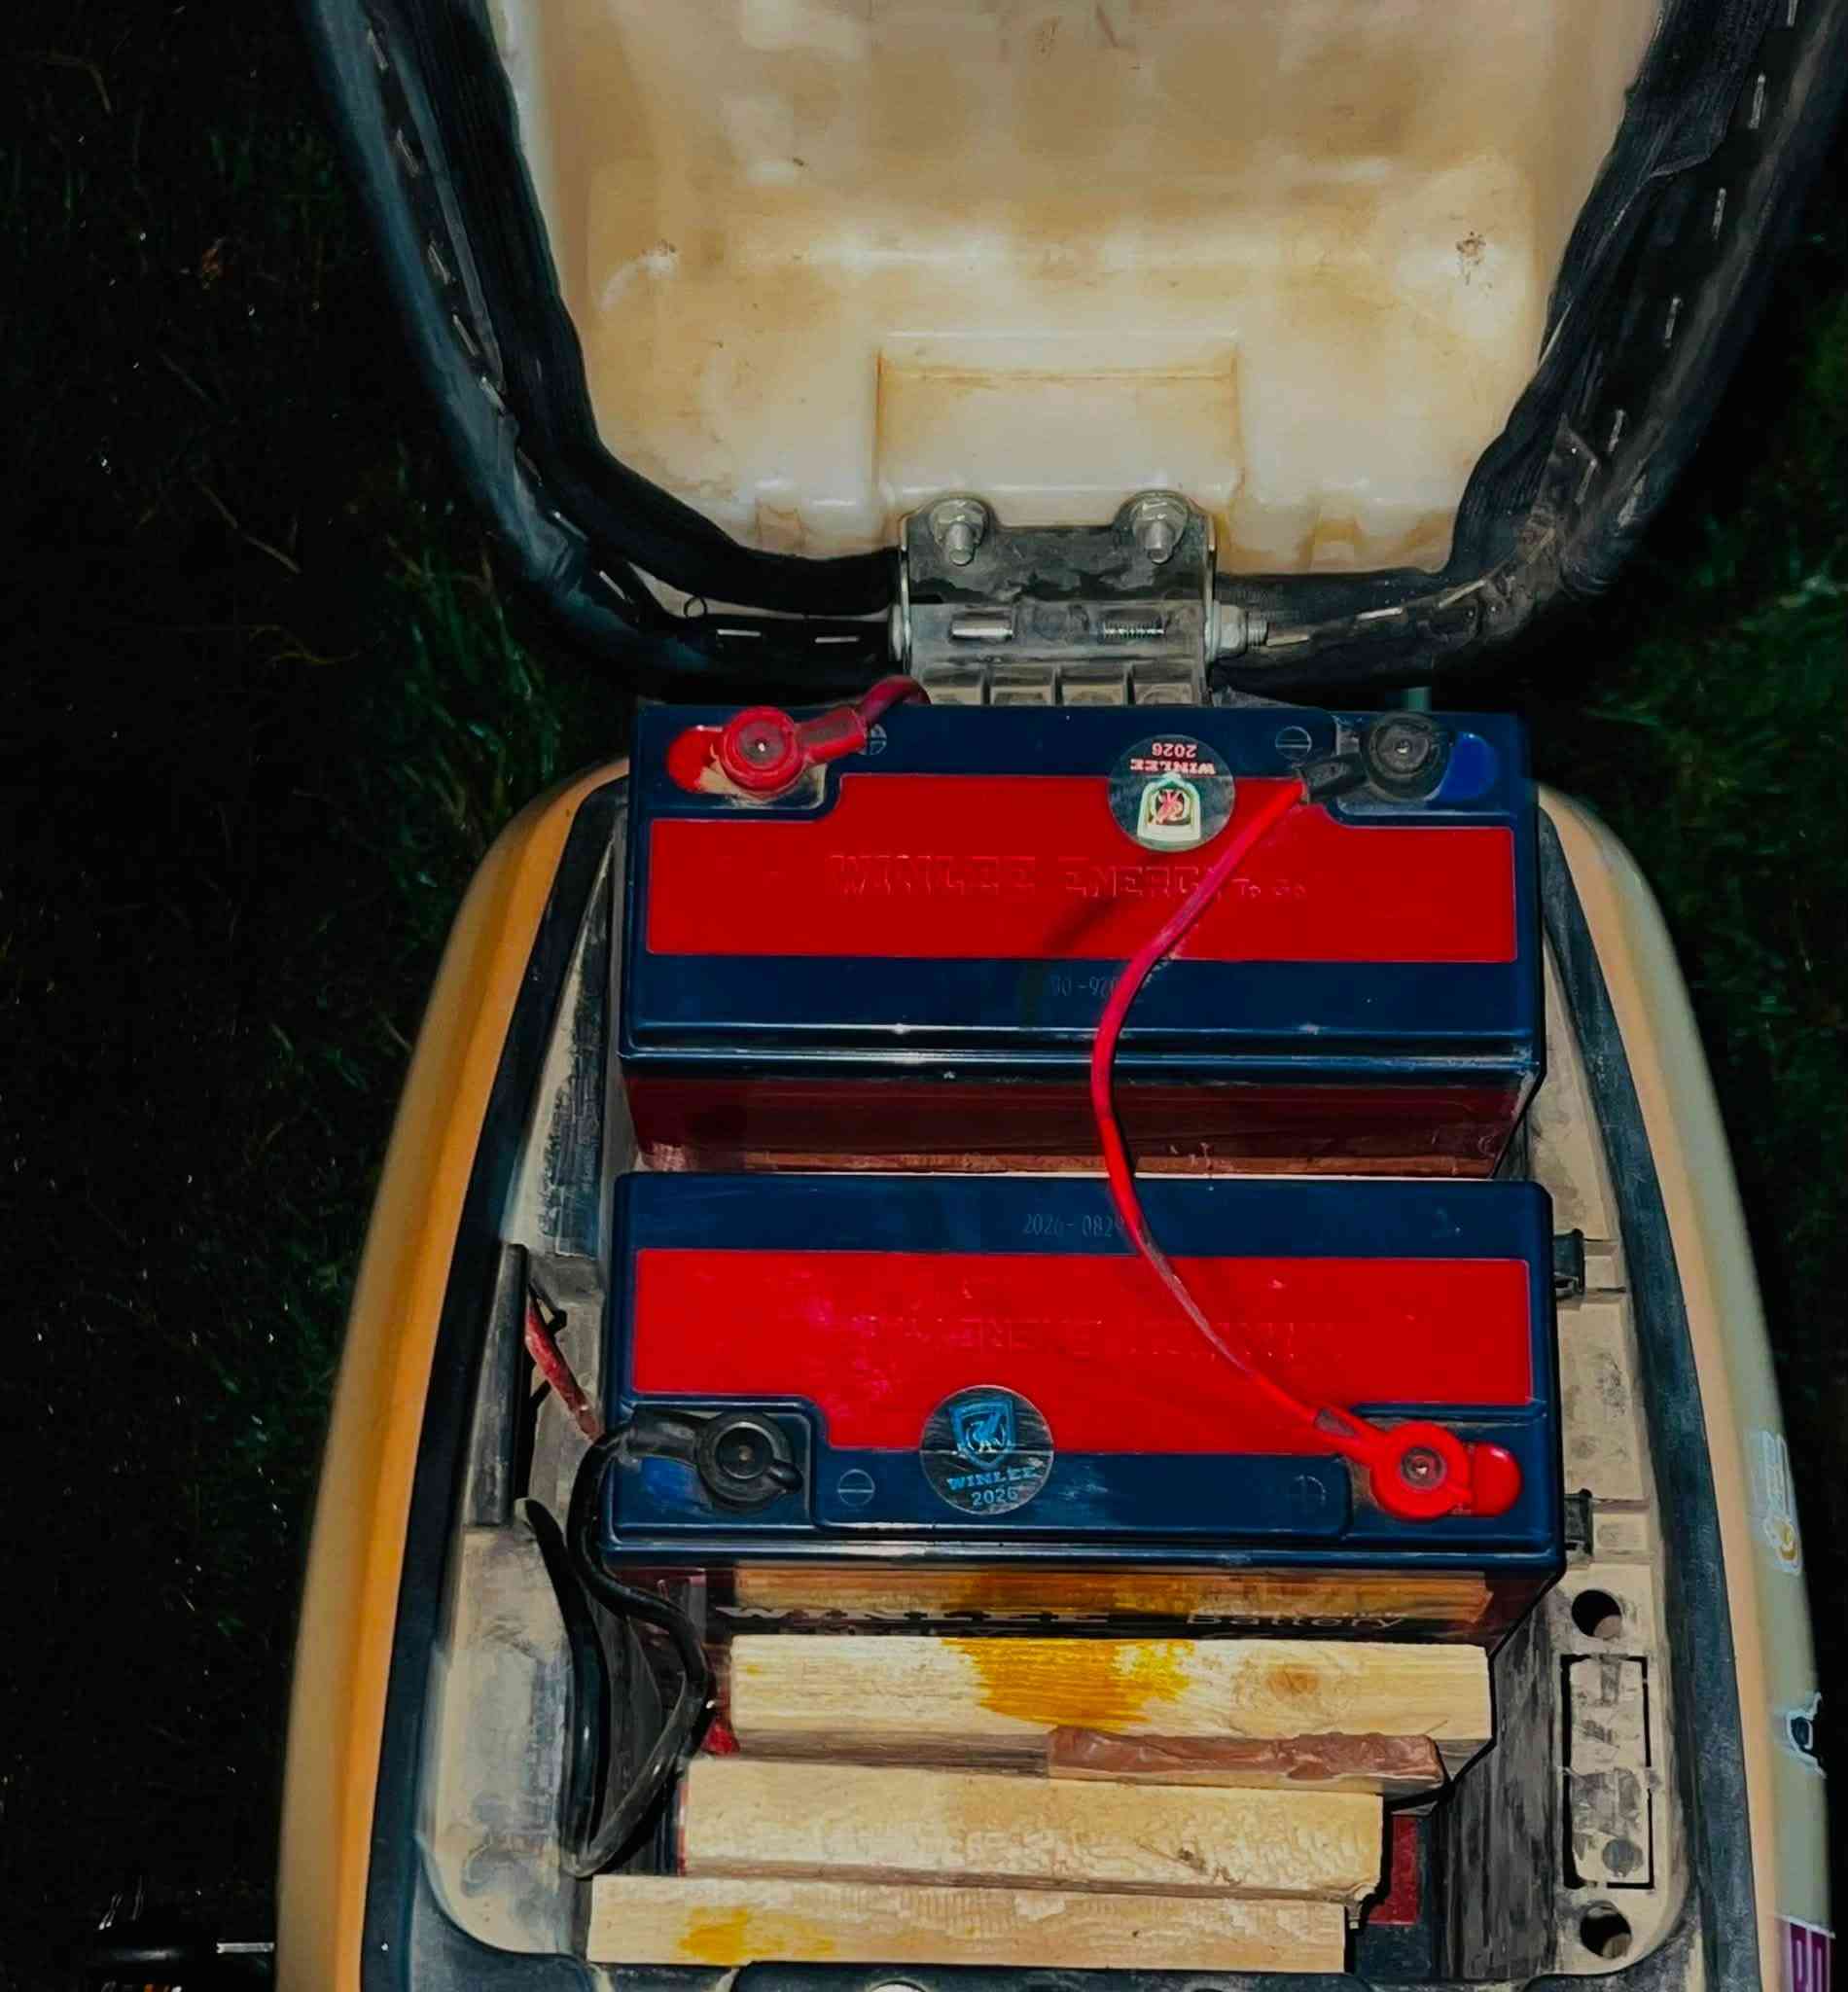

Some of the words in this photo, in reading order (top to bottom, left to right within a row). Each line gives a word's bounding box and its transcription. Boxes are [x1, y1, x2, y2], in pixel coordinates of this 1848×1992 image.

[1152, 742, 1197, 758] 2026
[1130, 758, 1216, 775] WINLEE
[1058, 856, 1221, 898] ENERG
[946, 1466, 1043, 1490] WINLEE
[972, 1486, 1018, 1507] 2026
